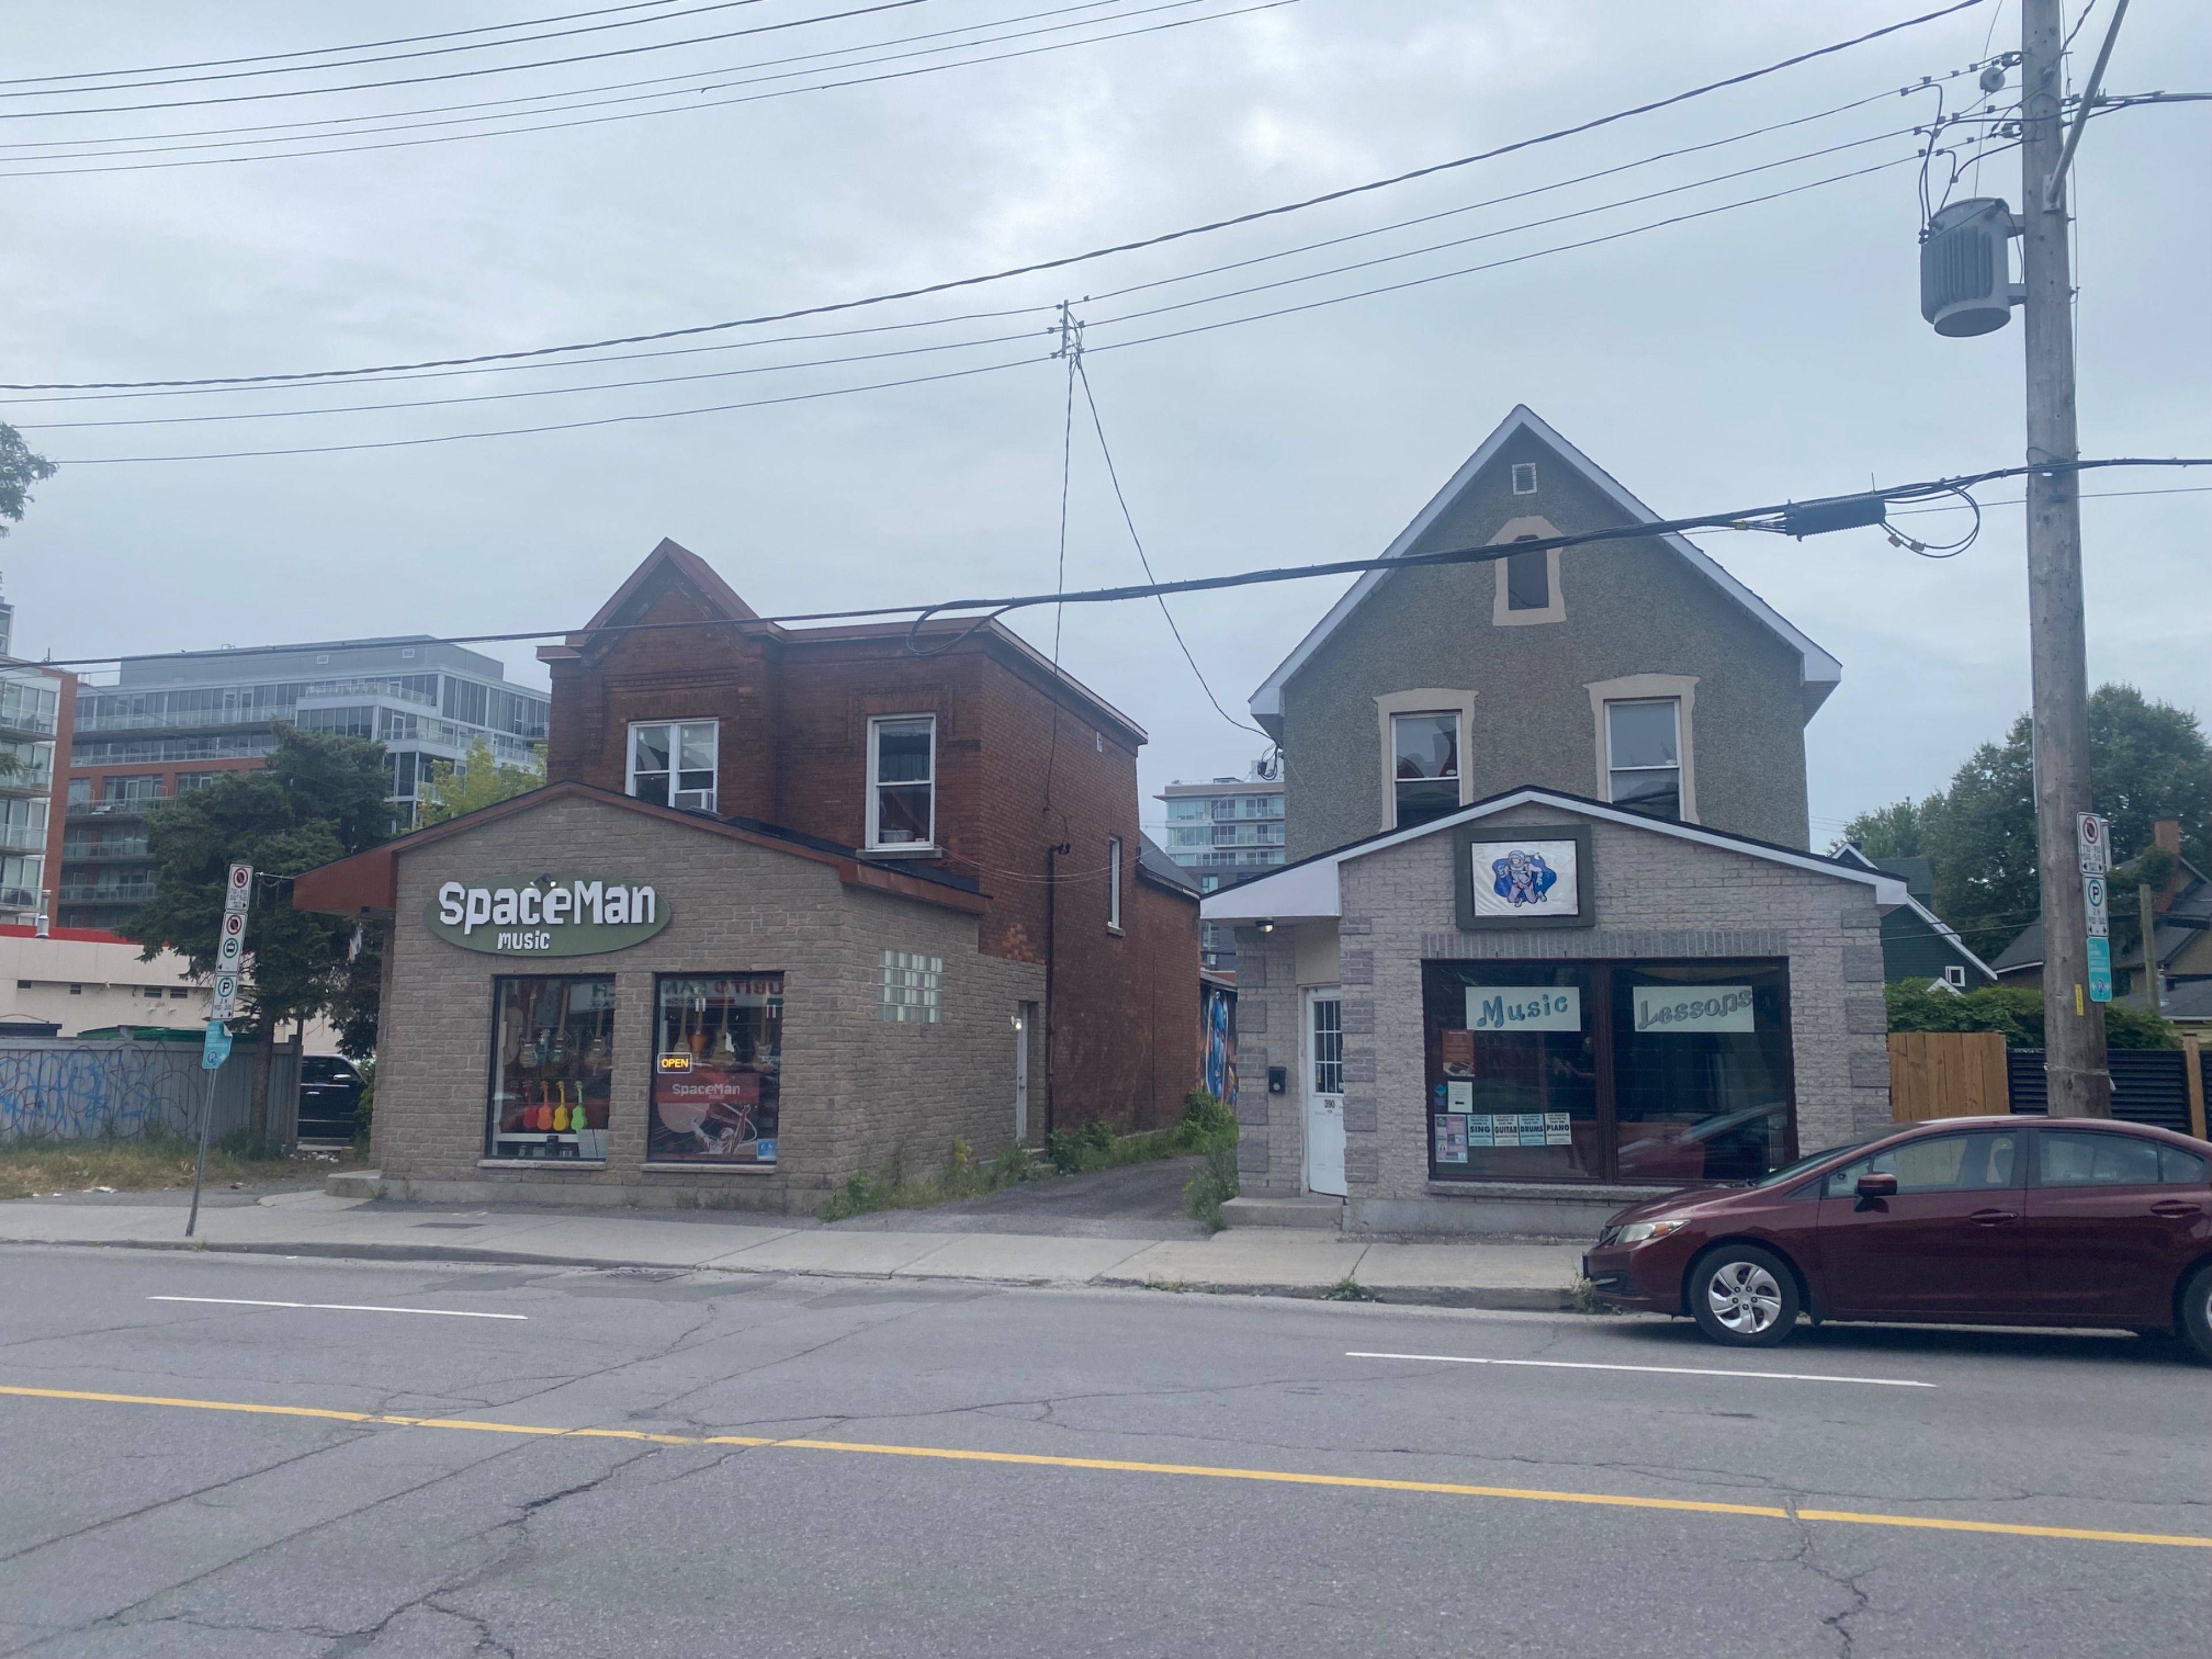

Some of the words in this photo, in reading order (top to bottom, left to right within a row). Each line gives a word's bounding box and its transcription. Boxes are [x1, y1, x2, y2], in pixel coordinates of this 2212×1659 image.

[2093, 886, 2100, 900] P
[438, 880, 656, 935] SpaceMan
[498, 930, 550, 950] music
[222, 982, 230, 993] P
[1477, 994, 1568, 1028] Music
[1638, 990, 1752, 1029] Lessons
[661, 1058, 689, 1068] OPEN
[672, 1084, 740, 1096] SpaceMan
[1324, 1099, 1336, 1108] 390
[1494, 1126, 1517, 1134] GUITAR
